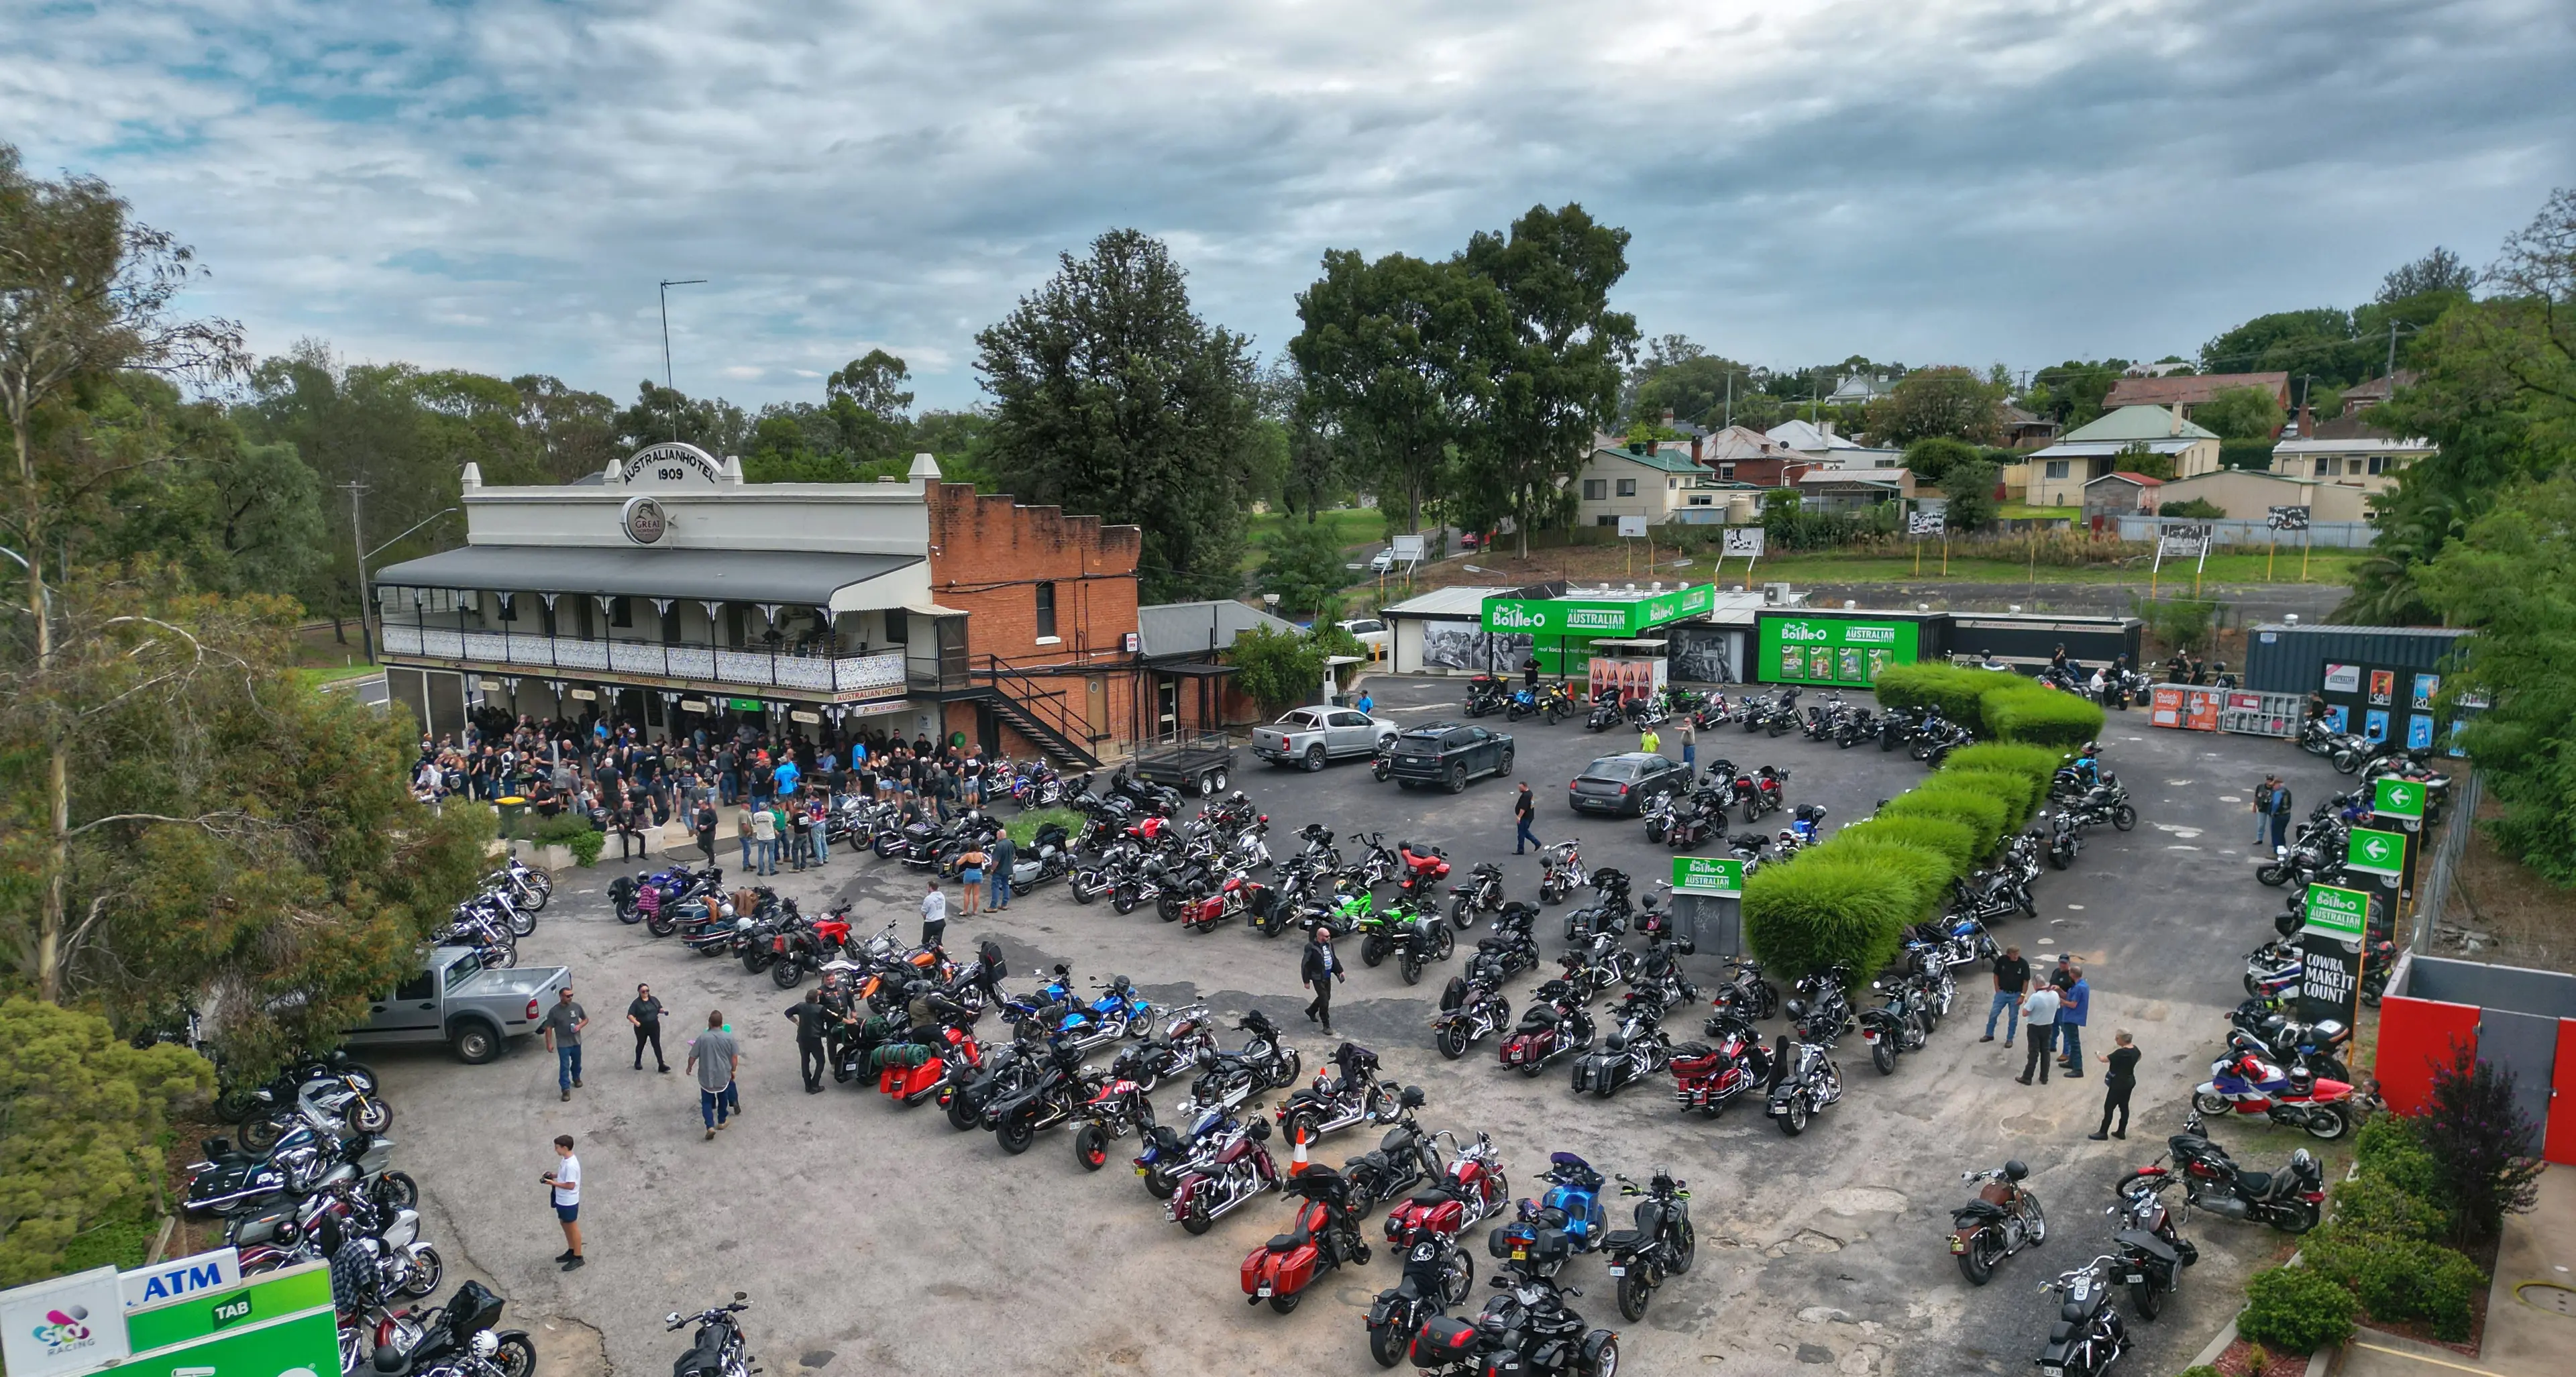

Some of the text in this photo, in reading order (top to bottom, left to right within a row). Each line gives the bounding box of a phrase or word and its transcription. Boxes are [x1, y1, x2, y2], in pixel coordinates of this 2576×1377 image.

[658, 468, 683, 480] 1909
[635, 520, 660, 529] GREAT
[1495, 604, 1509, 612] the
[1567, 613, 1625, 624] AUSTRALIAN
[1845, 630, 1894, 639] AUSTRALIAN
[618, 675, 667, 686] AUSTRALIAN HOTEL
[837, 686, 904, 702] AUSTRALIAN HOTEL
[2157, 692, 2177, 700] Quick
[1684, 876, 1729, 885] AUSTRALIAN
[2310, 909, 2361, 926] AUSTRALIAN
[2306, 952, 2346, 973] COWRA,
[2305, 967, 2355, 991] MAKE IT
[2304, 981, 2347, 1004] COUNT
[144, 1262, 222, 1302] ATM
[215, 1300, 249, 1320] TAB
[40, 1323, 83, 1345] SKY
[48, 1338, 95, 1357] RACING
